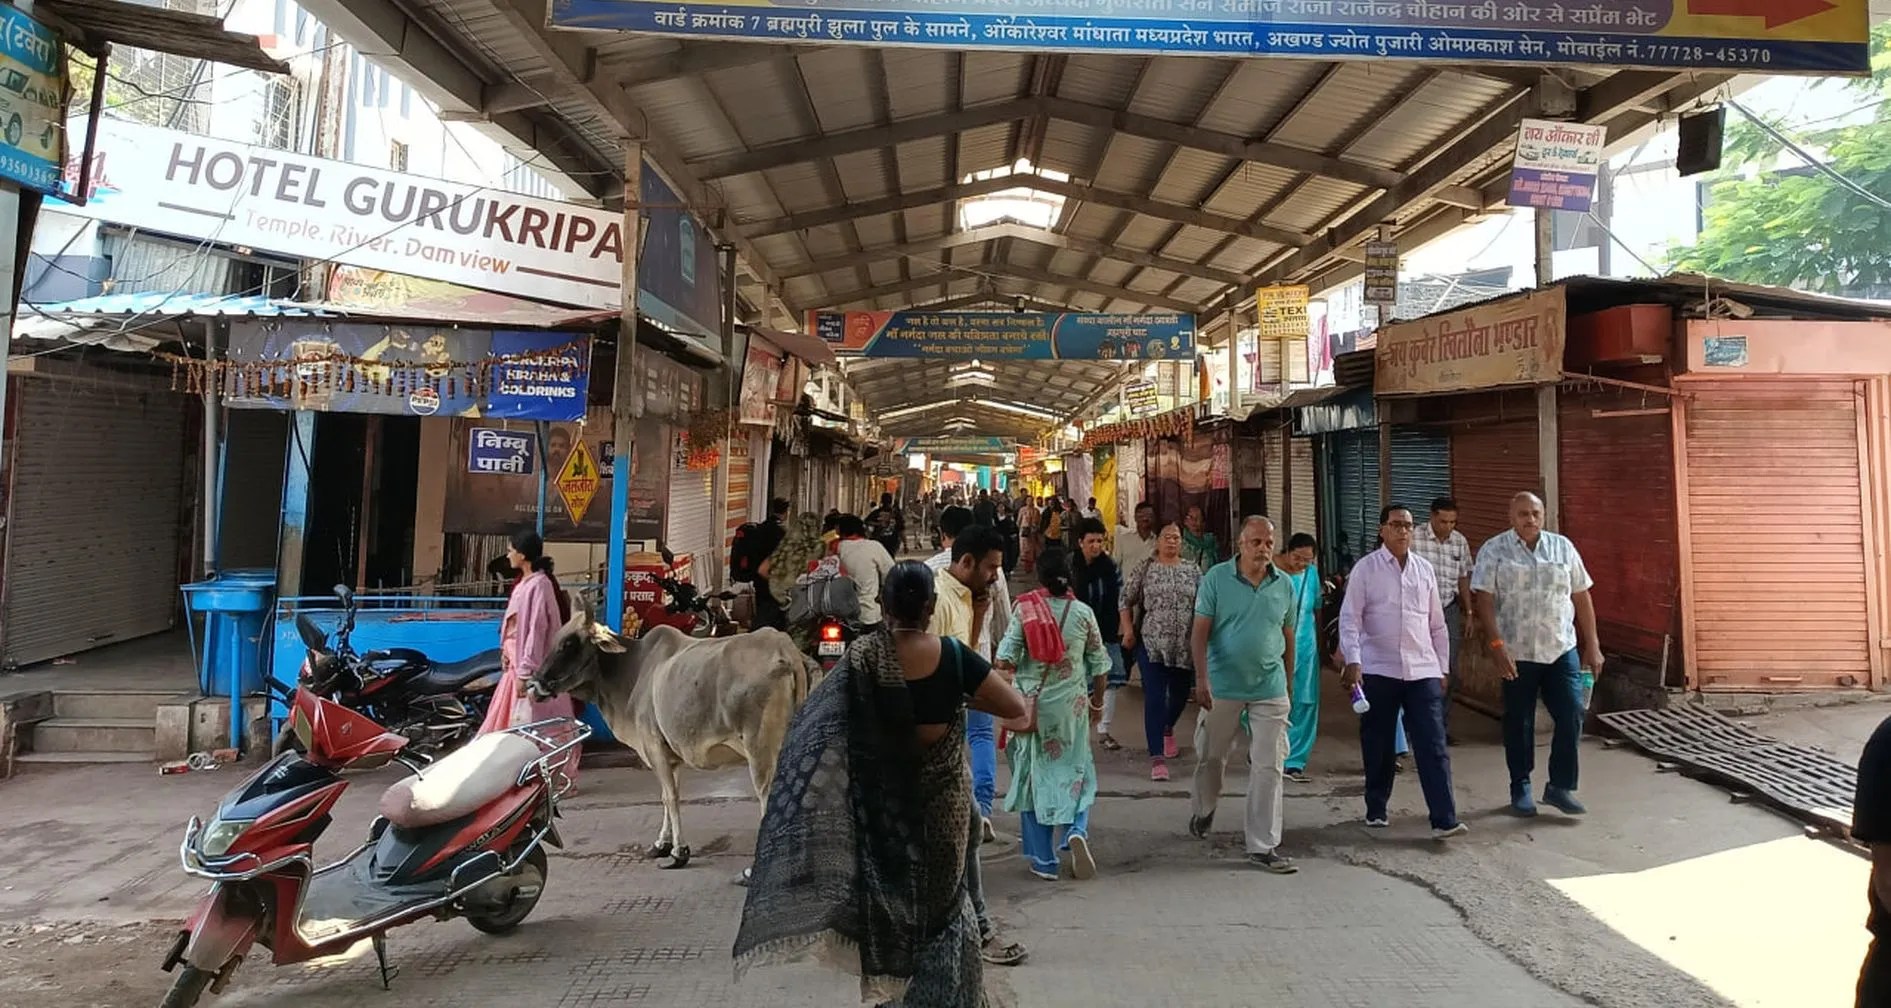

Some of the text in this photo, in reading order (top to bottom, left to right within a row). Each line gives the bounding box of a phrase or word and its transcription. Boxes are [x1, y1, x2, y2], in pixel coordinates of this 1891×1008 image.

[1221, 0, 1281, 15] समाज
[1288, 0, 1333, 17] राजा
[1338, 0, 1401, 20] राजेन्द्र
[1407, 0, 1465, 21] चौहान
[1470, 0, 1498, 21] की
[1503, 3, 1540, 22] ओर
[1545, 4, 1564, 24] से
[654, 7, 685, 27] वार्ड
[691, 10, 745, 30] क्रमांक
[750, 16, 760, 30] 7
[767, 13, 822, 37] ब्रह्मपुरी
[871, 21, 898, 41] पुल
[904, 16, 920, 36] के
[925, 18, 977, 40] सामने,
[1073, 21, 1130, 42] मांधाता
[1136, 24, 1207, 45] मध्यप्रदेश
[1213, 31, 1260, 49] भारत,
[1267, 31, 1323, 48] अखण्ड
[1328, 28, 1369, 49] ज्योत
[1375, 31, 1422, 55] पुजारी
[1429, 33, 1514, 55] ओमप्रकाश
[1519, 35, 1551, 57] सेन,
[1556, 37, 1622, 59] मोबाईल
[165, 142, 623, 263] HOTEL GURUKRIPA
[405, 237, 454, 265] Dam
[460, 249, 511, 274] view
[501, 384, 576, 398] COLDRINKS
[477, 430, 530, 457] निम्बू
[477, 454, 525, 473] पानी
